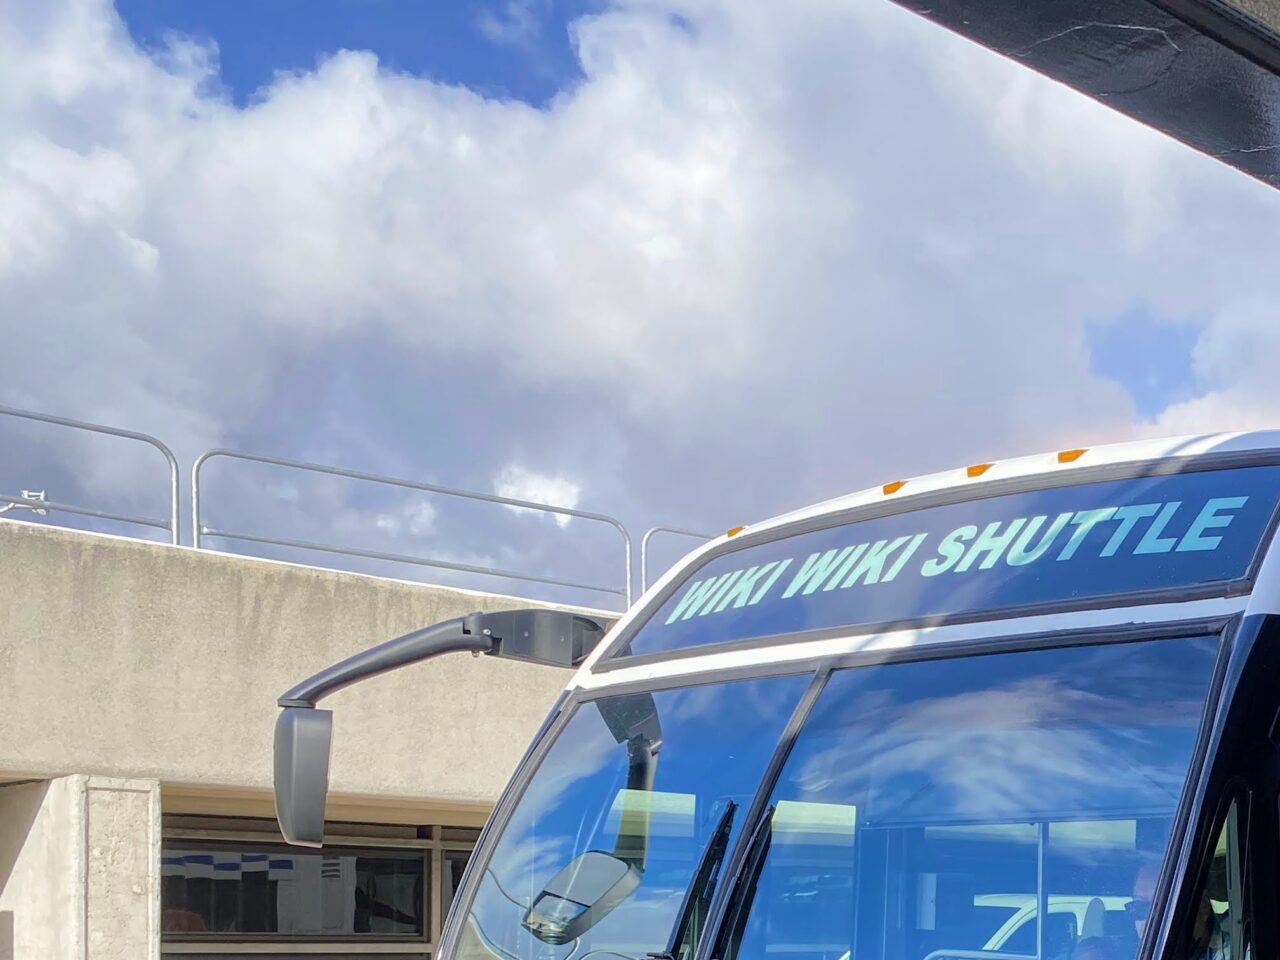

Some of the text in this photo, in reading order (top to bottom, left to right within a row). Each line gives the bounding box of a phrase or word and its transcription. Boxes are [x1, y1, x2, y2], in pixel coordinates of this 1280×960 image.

[664, 495, 1249, 625] WIKI WIKI SHUTTLE
